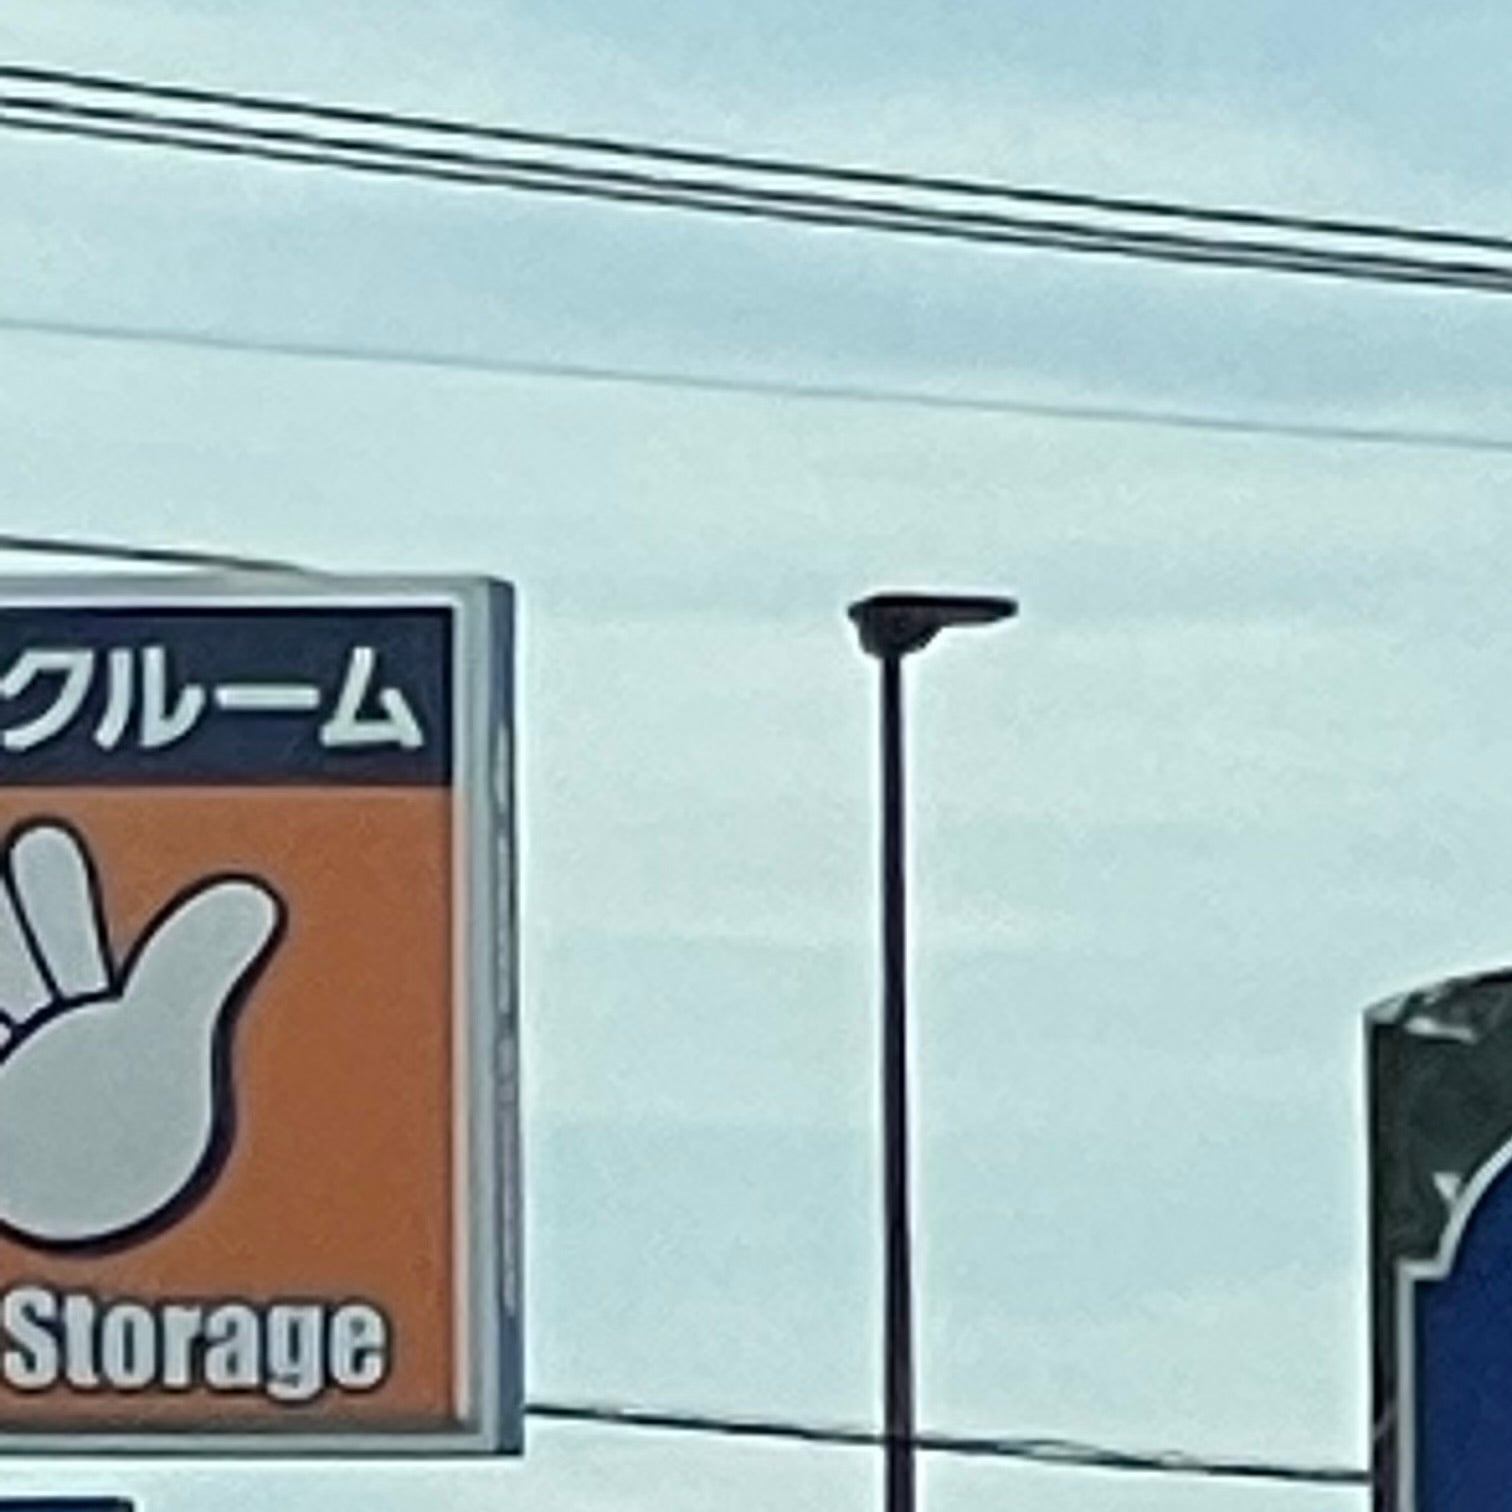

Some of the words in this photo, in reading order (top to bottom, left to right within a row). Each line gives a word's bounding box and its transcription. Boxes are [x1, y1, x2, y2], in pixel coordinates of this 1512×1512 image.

[0, 646, 424, 751] クルーム
[1, 1284, 388, 1401] Storage
